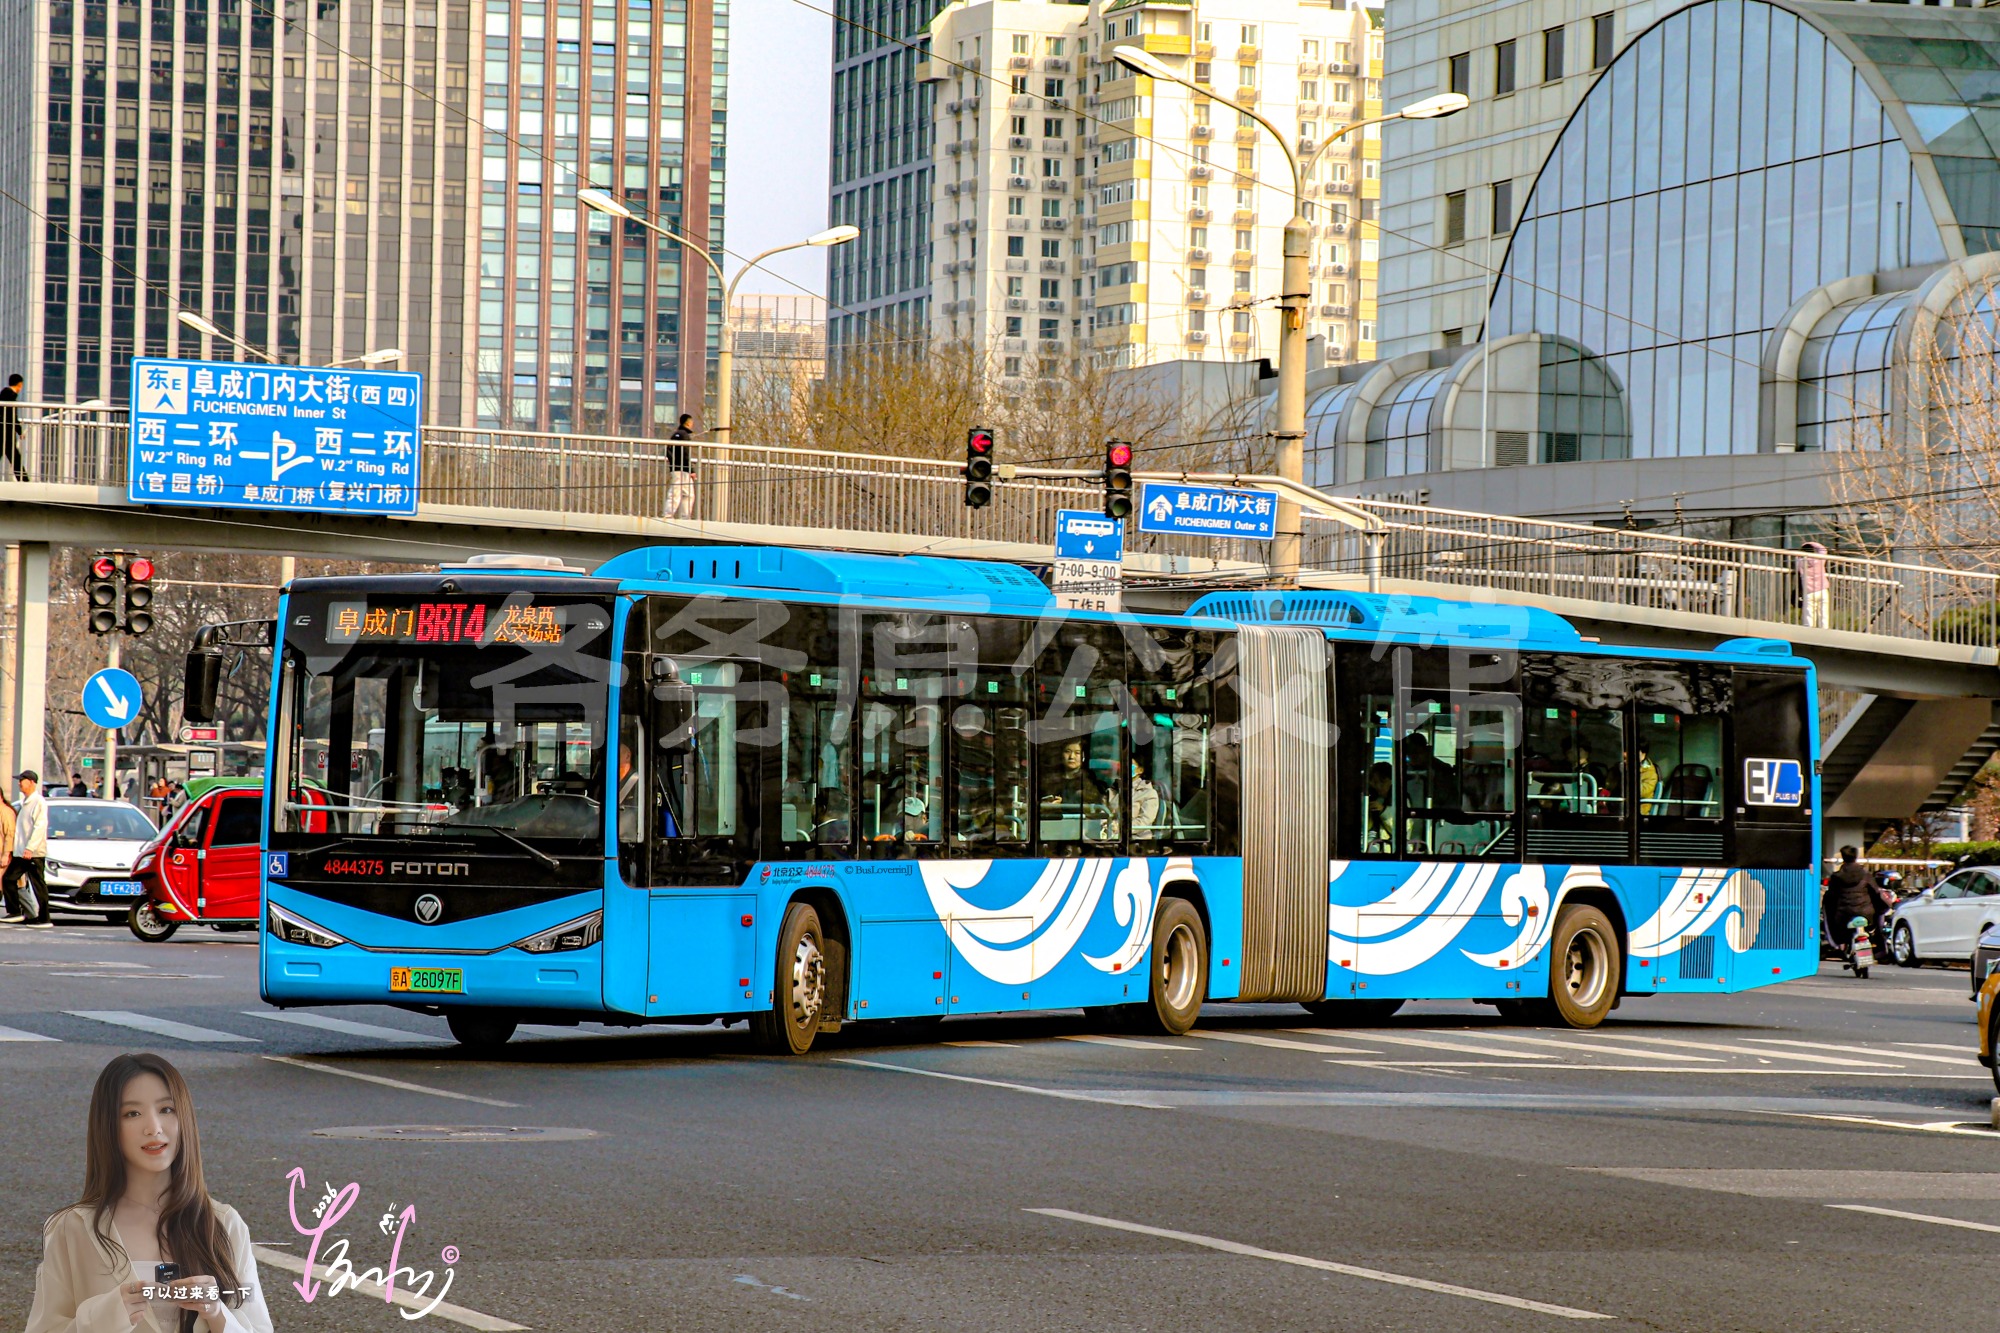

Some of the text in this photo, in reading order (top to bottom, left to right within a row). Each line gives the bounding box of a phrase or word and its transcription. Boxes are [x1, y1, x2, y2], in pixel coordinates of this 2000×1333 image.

[193, 400, 346, 420] FUCHENGMEN Inner St
[137, 418, 239, 450] 西二环
[314, 427, 413, 460] 西二环
[177, 453, 206, 467] Ring
[213, 454, 231, 466] Rd
[356, 461, 385, 475] Ring
[392, 462, 409, 475] Rd
[1175, 492, 1271, 516] 阜成门外大街
[1174, 516, 1268, 532] FUCHENGMEN Outer St
[335, 607, 414, 637] 阜成门
[416, 603, 486, 642] BRT4
[504, 605, 556, 625] 龙泉西
[493, 624, 562, 643] 公交场站
[324, 860, 469, 876] 4844375 FOTON
